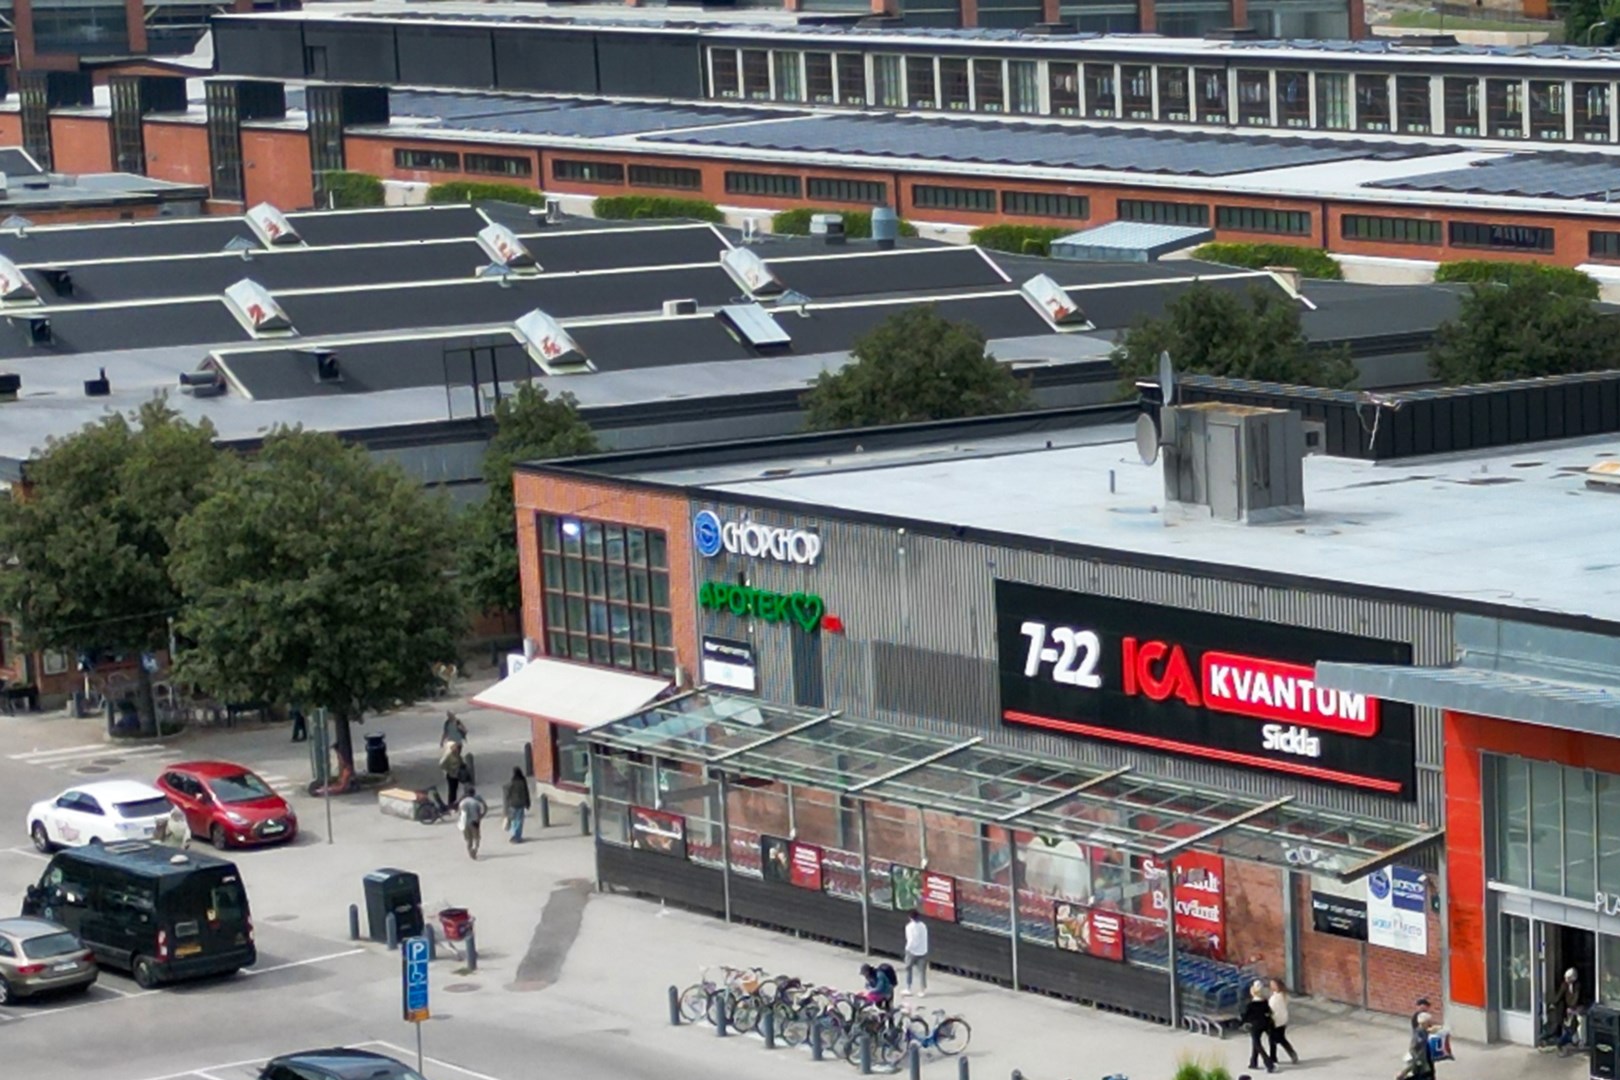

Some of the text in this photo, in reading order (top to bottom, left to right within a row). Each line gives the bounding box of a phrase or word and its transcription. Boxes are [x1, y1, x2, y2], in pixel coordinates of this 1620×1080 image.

[722, 521, 822, 565] CHOPCHOP
[700, 581, 791, 624] APOTEK
[1020, 620, 1367, 723] 7-22 ICA KVANTUM
[1262, 723, 1320, 758] Sickla
[412, 942, 425, 960] P
